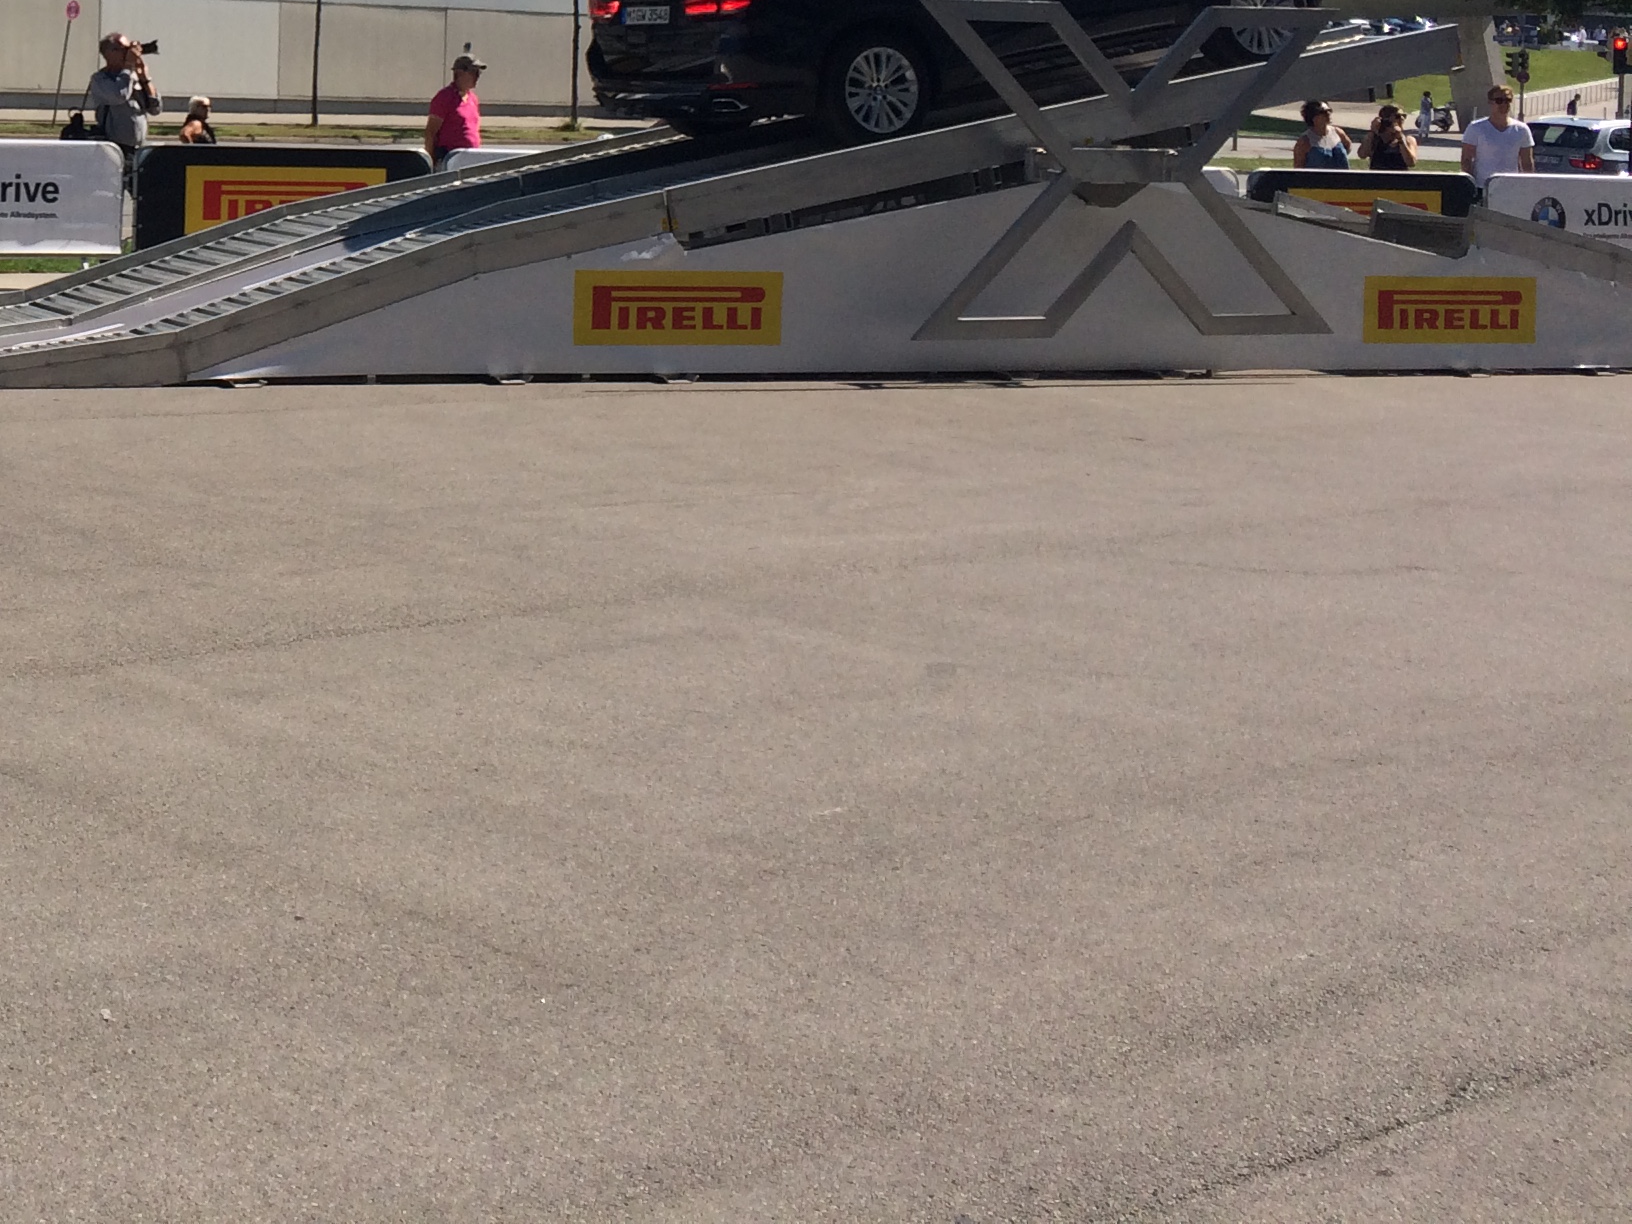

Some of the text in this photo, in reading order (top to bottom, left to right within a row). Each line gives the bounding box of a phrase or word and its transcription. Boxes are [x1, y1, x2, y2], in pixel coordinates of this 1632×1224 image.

[1583, 202, 1632, 227] xDri
[591, 285, 766, 330] PIRELLI
[1377, 289, 1523, 330] PIRELLI
